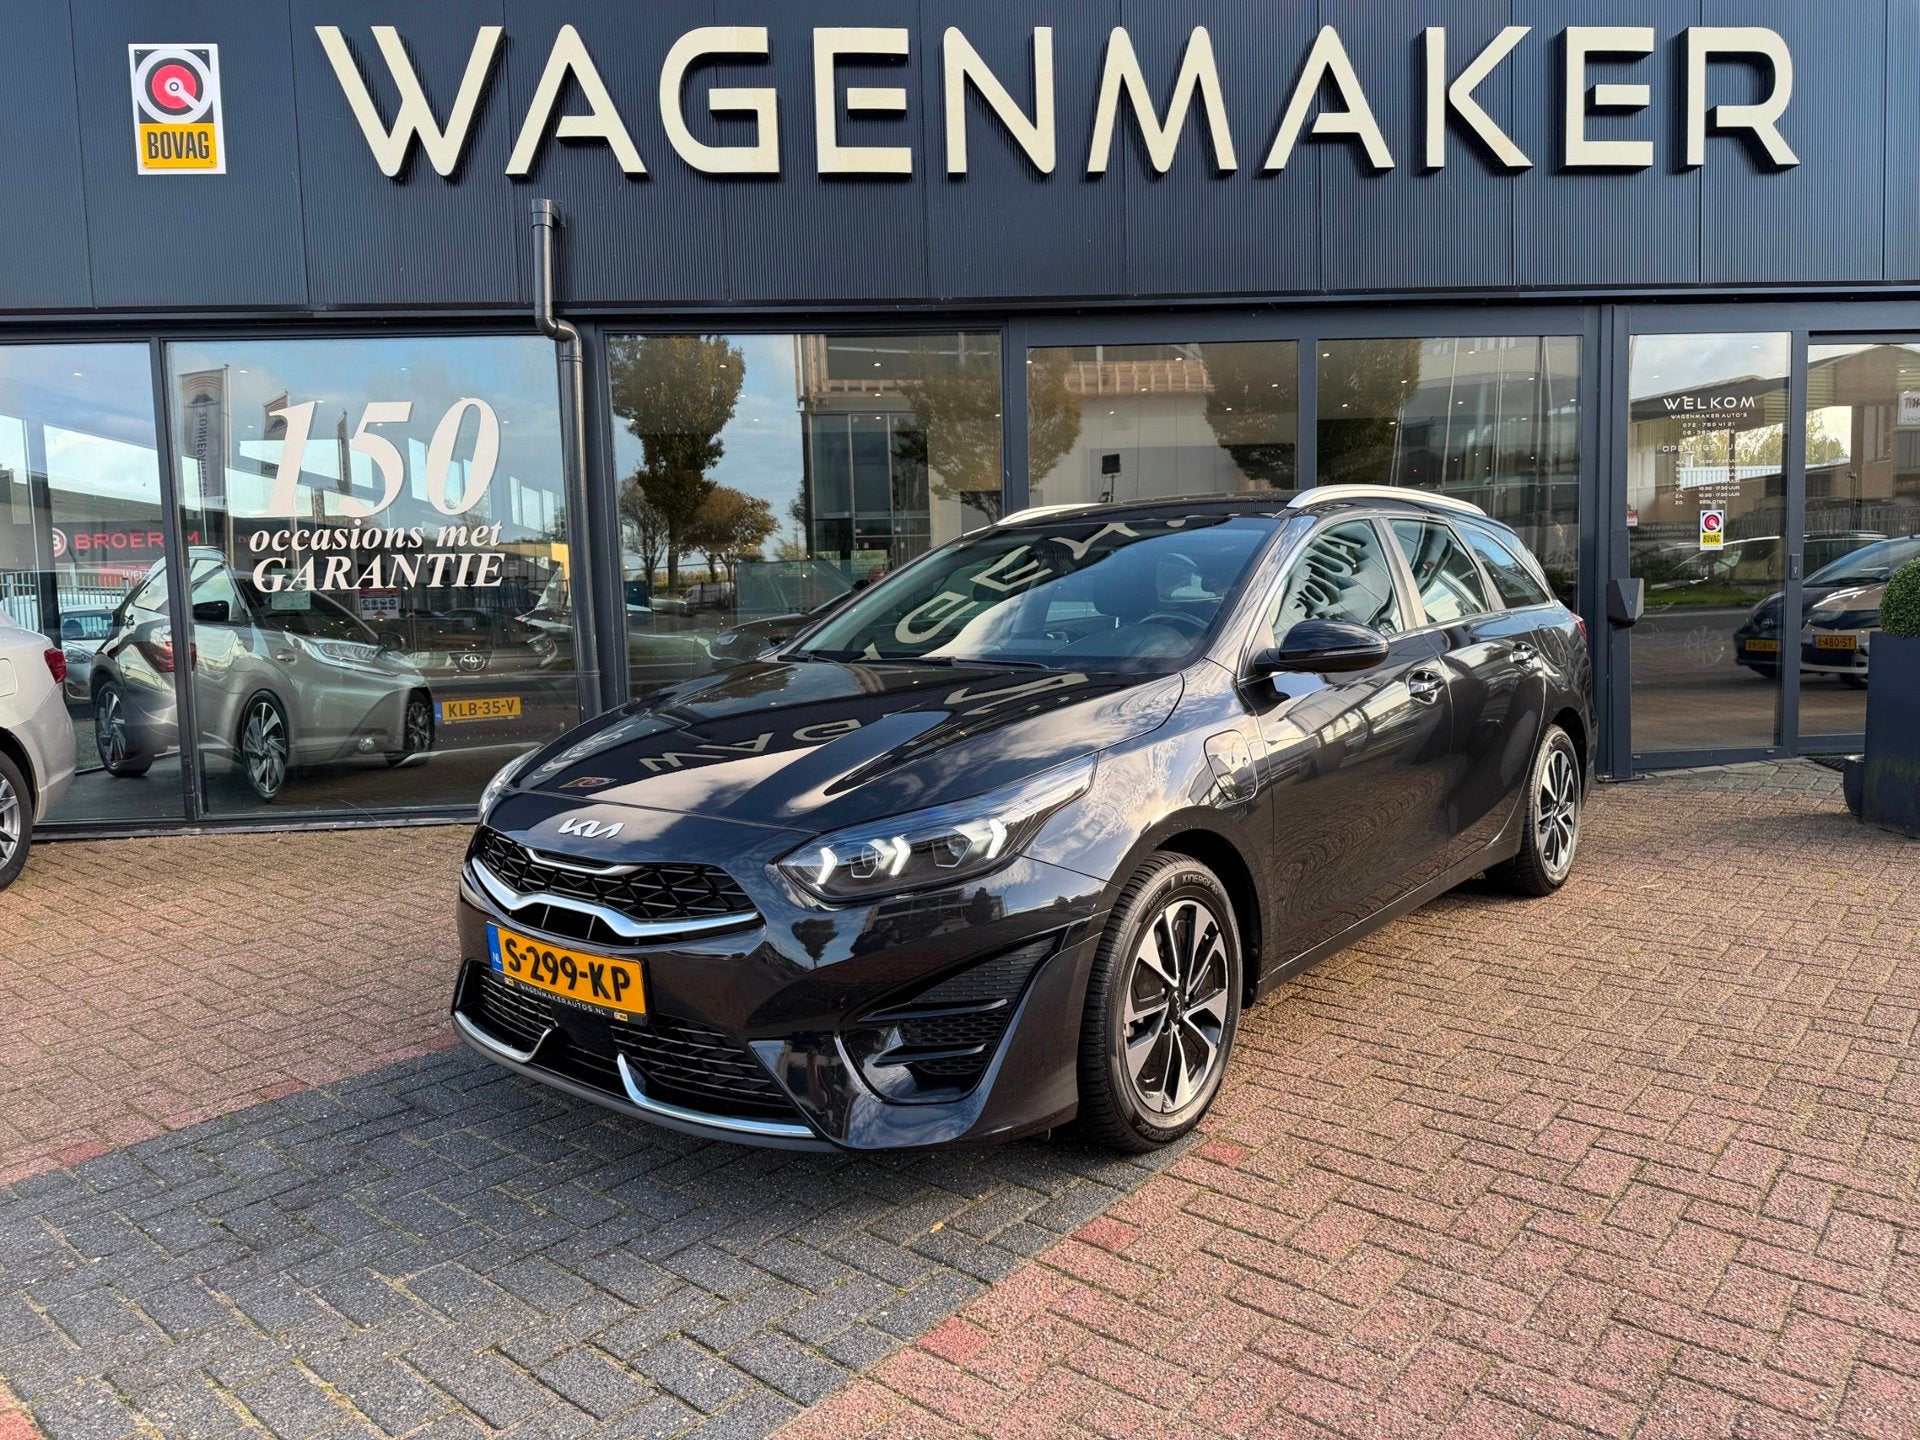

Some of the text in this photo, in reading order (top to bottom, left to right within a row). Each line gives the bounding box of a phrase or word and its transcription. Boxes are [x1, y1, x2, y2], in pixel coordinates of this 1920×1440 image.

[315, 24, 1801, 177] WAGENMAKER
[146, 130, 210, 160] BOVAG
[1663, 396, 1755, 410] WELKOM
[257, 397, 500, 518] 150
[249, 518, 504, 552] occasions met
[1702, 534, 1721, 544] BOVAG
[252, 552, 506, 593] GARANTIE
[448, 699, 515, 718] KLB-35-V
[557, 817, 626, 840] KIA
[492, 936, 631, 1002] NL S-299-KP
[519, 983, 607, 1017] WAGENMAKERAUTOS.NL
